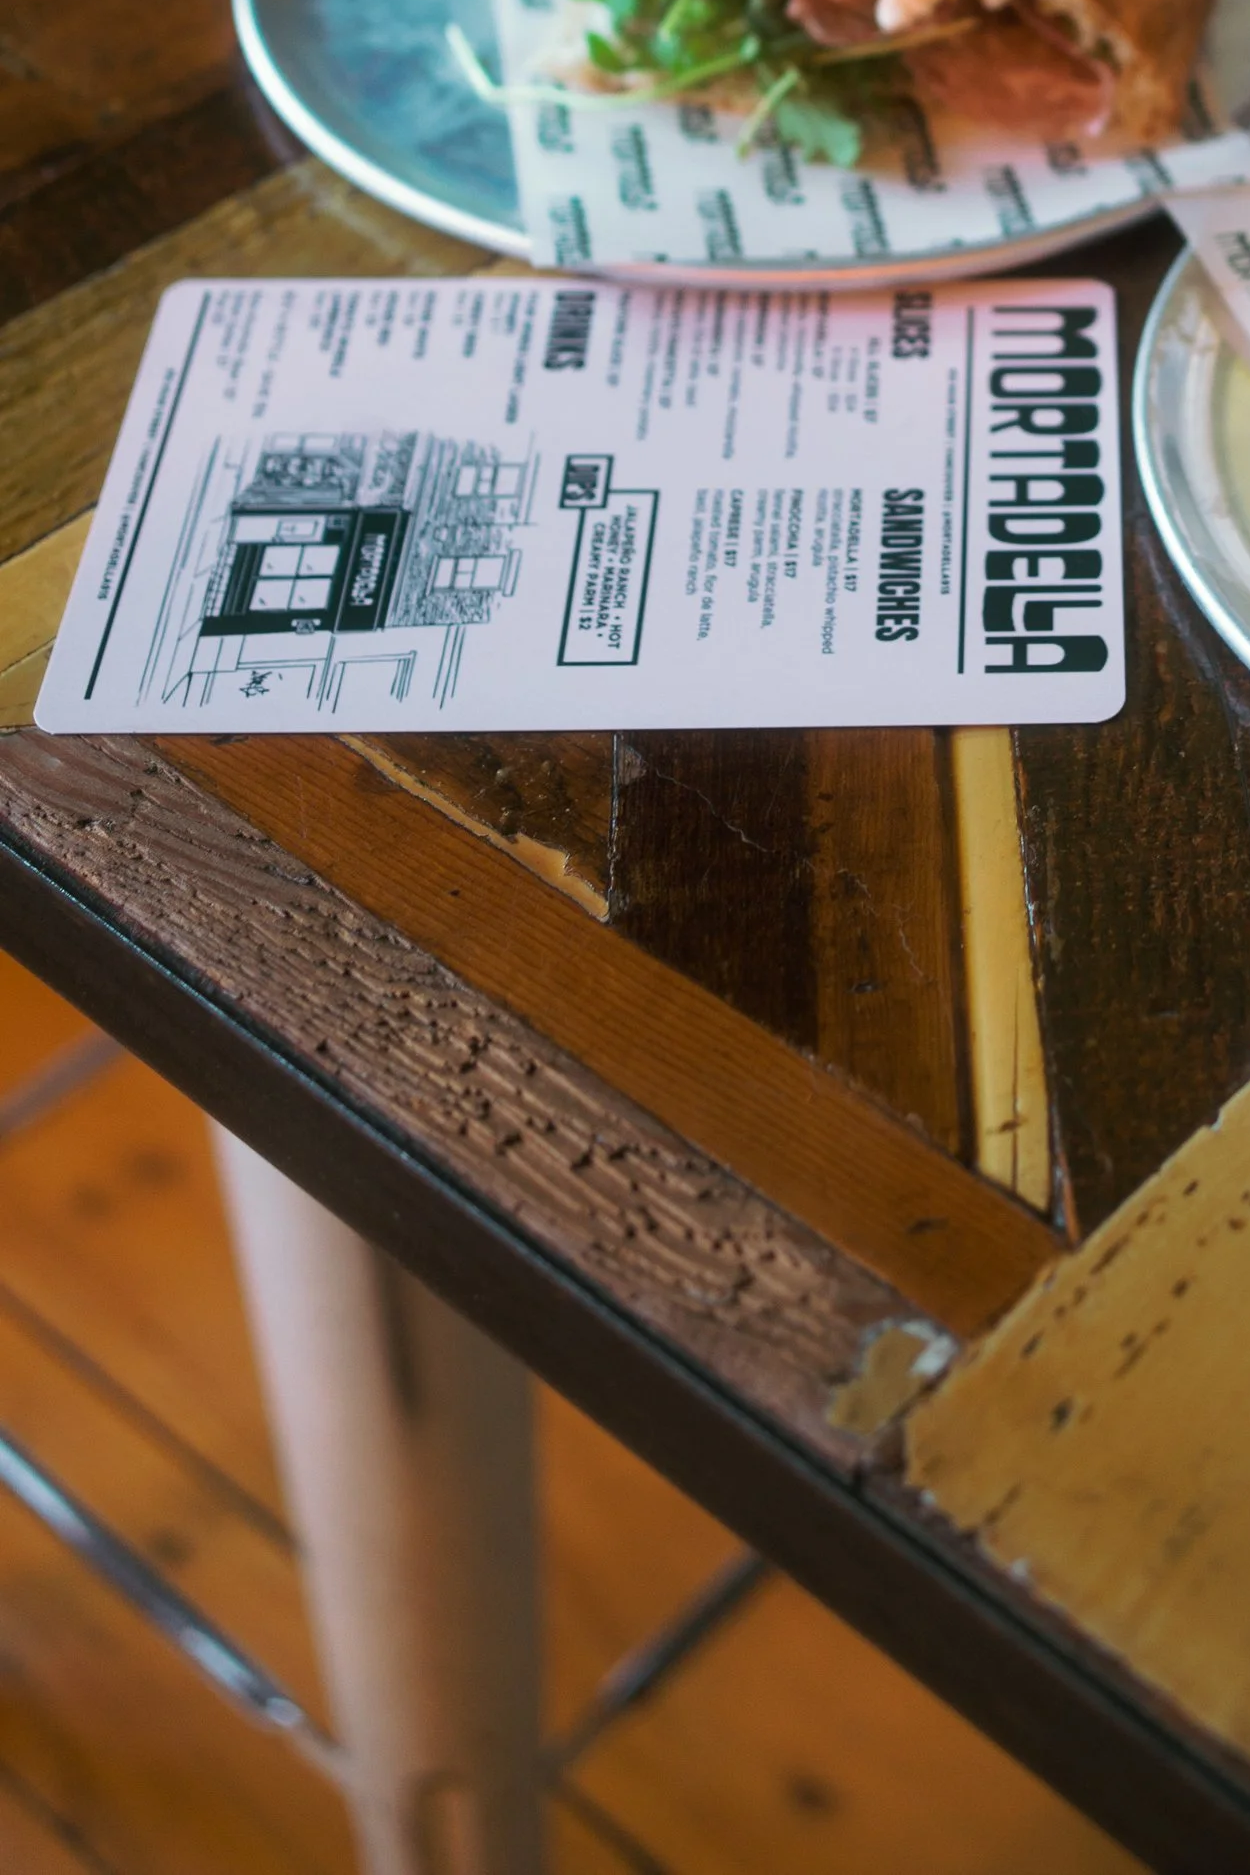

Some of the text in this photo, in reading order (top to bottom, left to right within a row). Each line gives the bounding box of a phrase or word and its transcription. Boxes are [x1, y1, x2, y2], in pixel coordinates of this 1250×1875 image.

[543, 291, 595, 369] DRINKS
[723, 489, 743, 567] CAPRESE $17
[784, 488, 803, 578] FINOCCHIA $17
[982, 304, 1108, 673] MORTADELLA
[578, 522, 605, 630] CREAMY PARM $2
[595, 515, 621, 628] HONEY MARINARA
[606, 505, 636, 648] JALAPEÑO RANCH HOT
[685, 564, 698, 595] ranch
[823, 555, 838, 604] pistachio
[844, 488, 861, 591] MORTADELLA $17
[874, 488, 924, 641] SANDWICHES
[701, 596, 713, 610] de
[821, 606, 835, 654] whipped
